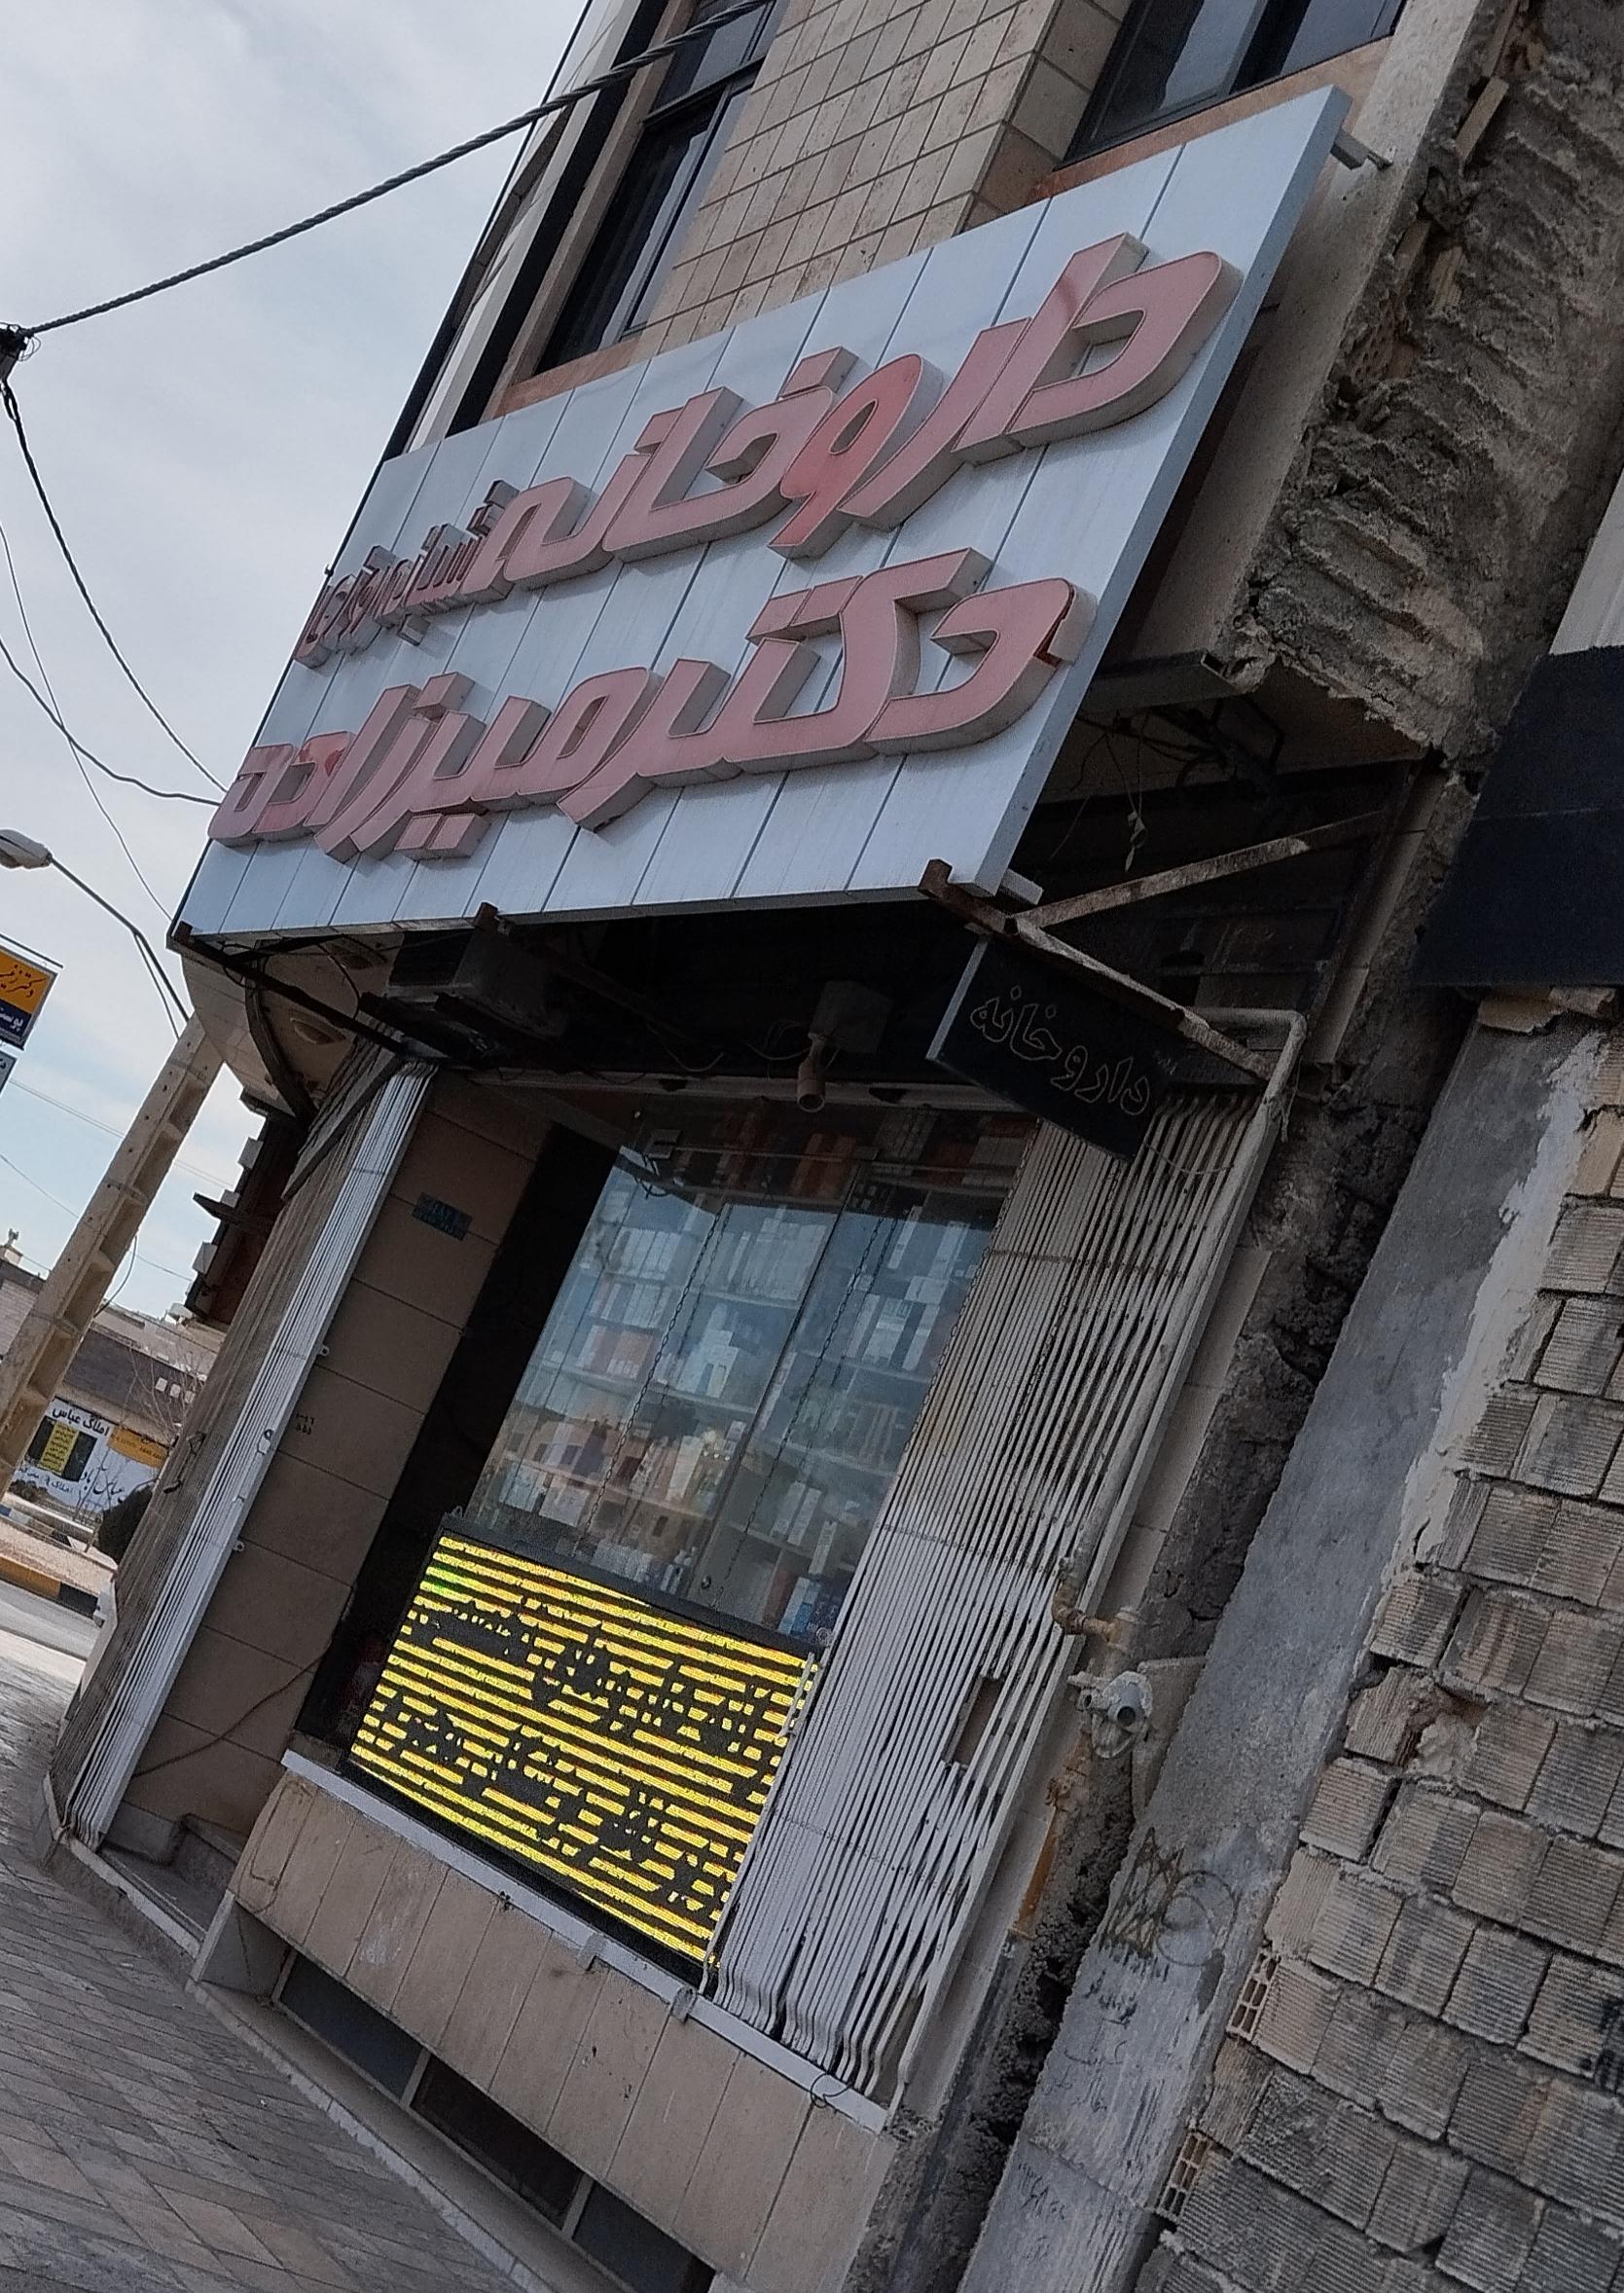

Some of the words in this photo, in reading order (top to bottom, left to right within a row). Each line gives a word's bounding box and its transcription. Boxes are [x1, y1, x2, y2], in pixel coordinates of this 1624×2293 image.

[460, 234, 1241, 600] داروخانه
[207, 666, 658, 862] میرزاده
[558, 547, 1092, 831] دکتر
[970, 985, 1150, 1116] داروخانه
[52, 1407, 82, 1425] عباس
